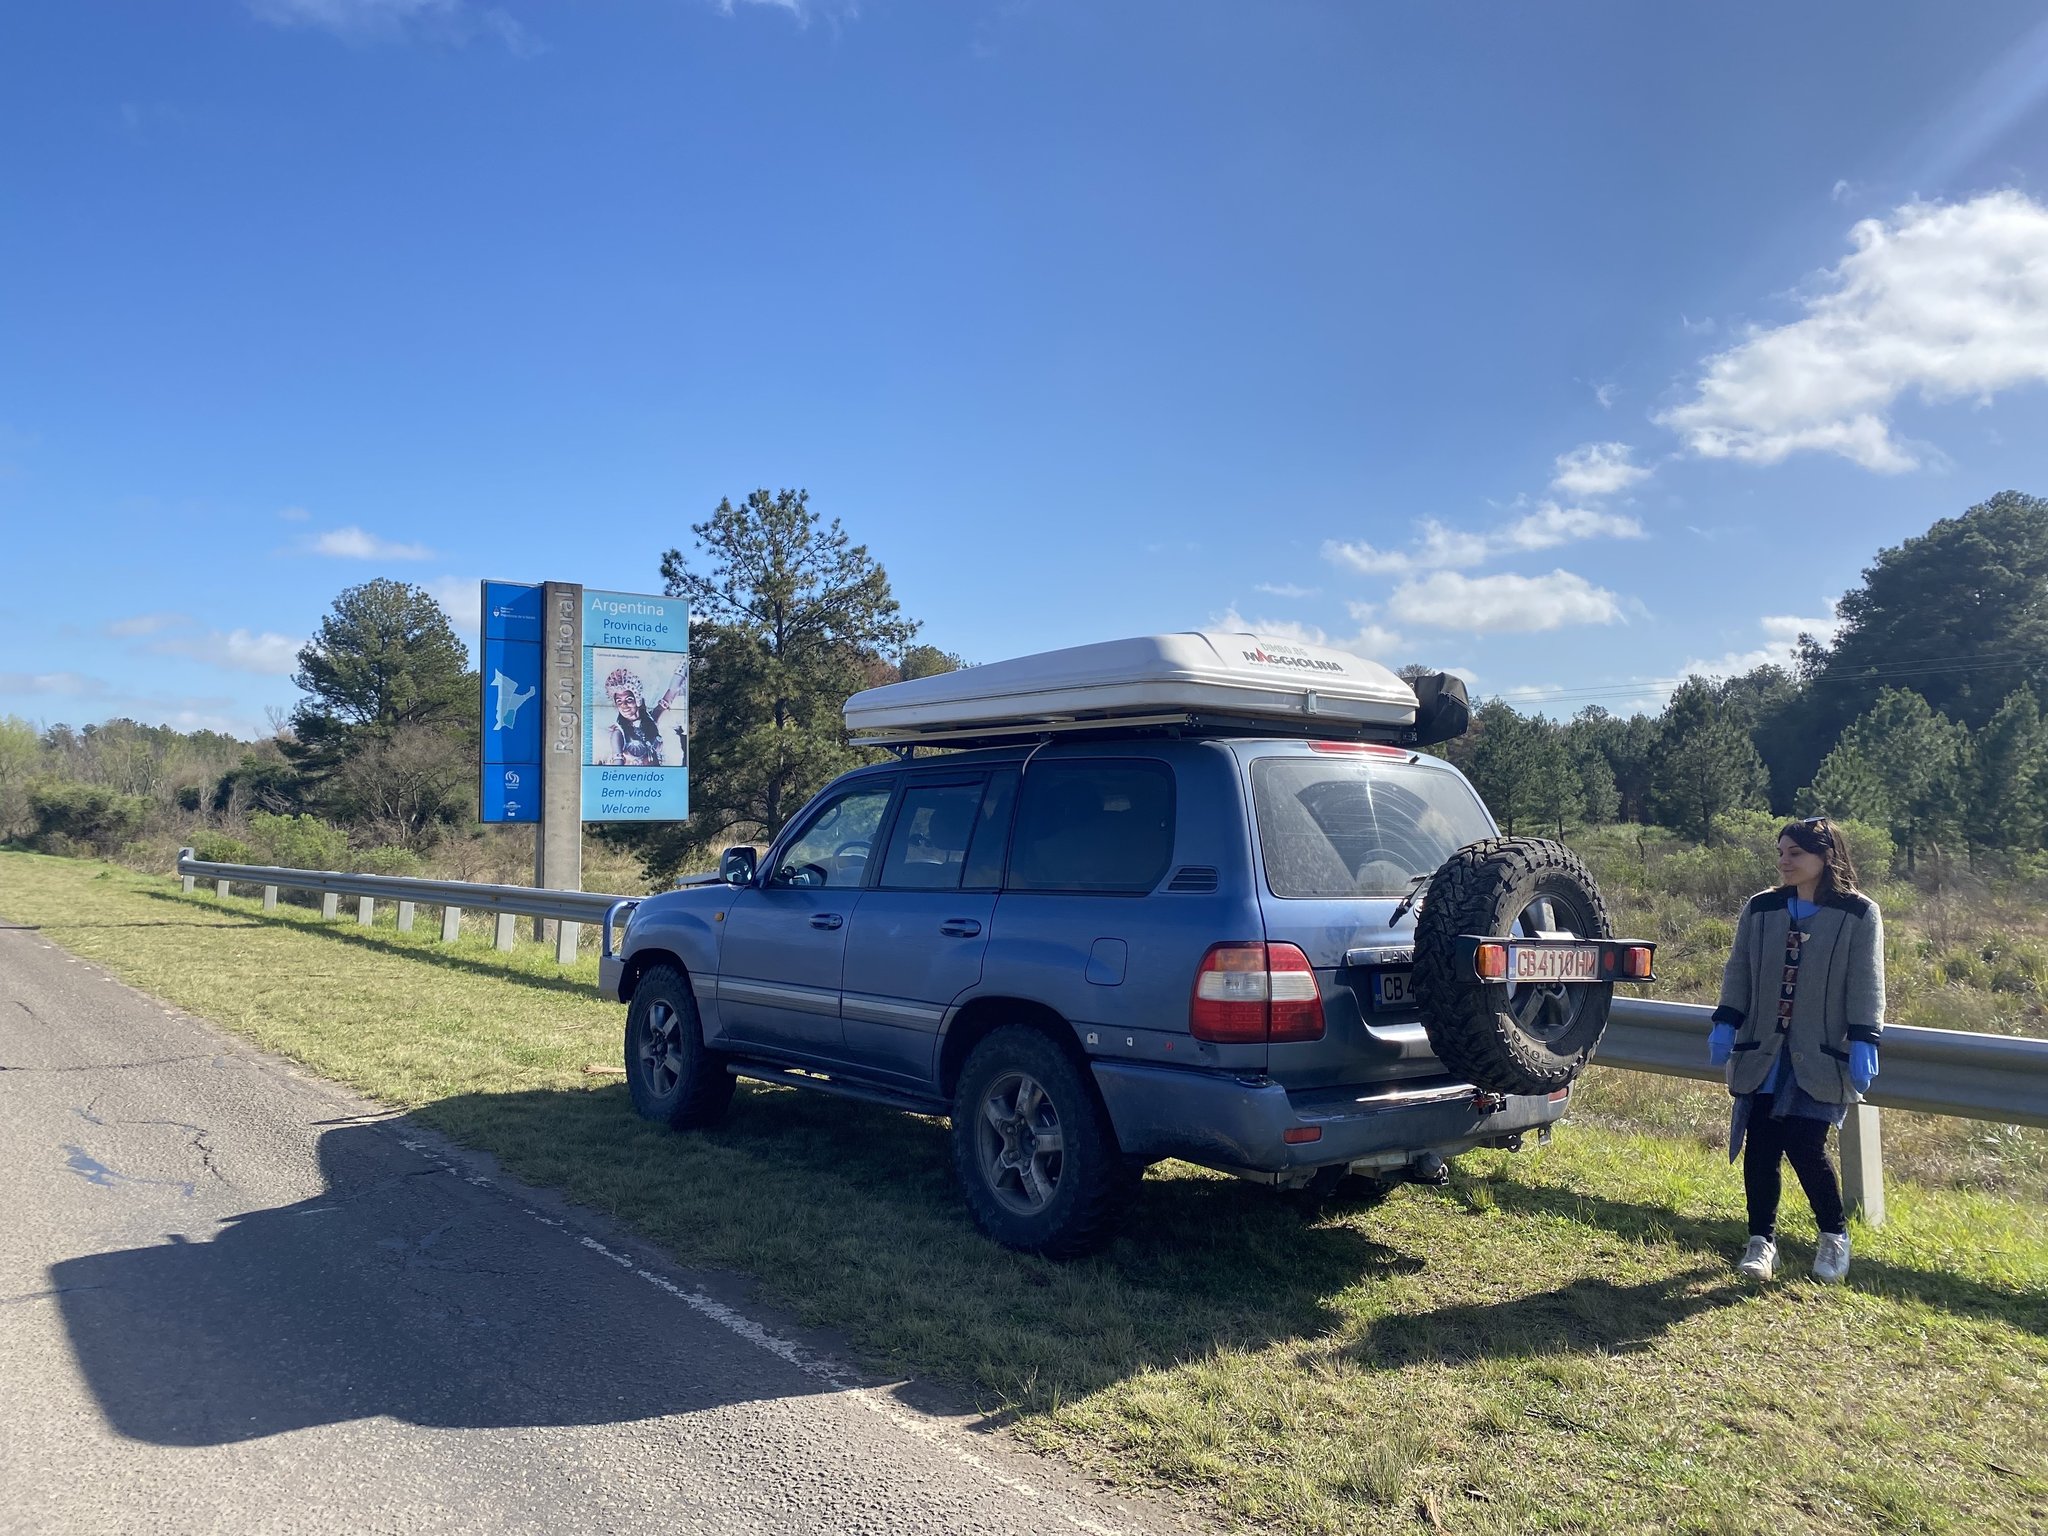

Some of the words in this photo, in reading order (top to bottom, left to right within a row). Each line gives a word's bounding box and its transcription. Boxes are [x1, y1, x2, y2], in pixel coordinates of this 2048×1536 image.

[591, 598, 664, 616] Argentina
[555, 590, 575, 669] Litoral
[603, 618, 652, 632] Provincia
[654, 622, 668, 633] de
[603, 633, 632, 645] Entre
[634, 635, 657, 647] Ríos
[1242, 648, 1344, 672] MAGGIOLINA
[553, 676, 579, 754] Región
[601, 771, 665, 782] Bienvenidos
[601, 787, 662, 798] Bem-vindos
[601, 803, 650, 814] Welcome
[1381, 950, 1415, 964] LAN
[1518, 950, 1537, 976] CB
[1537, 950, 1575, 976] 4110
[1383, 976, 1404, 1001] CB
